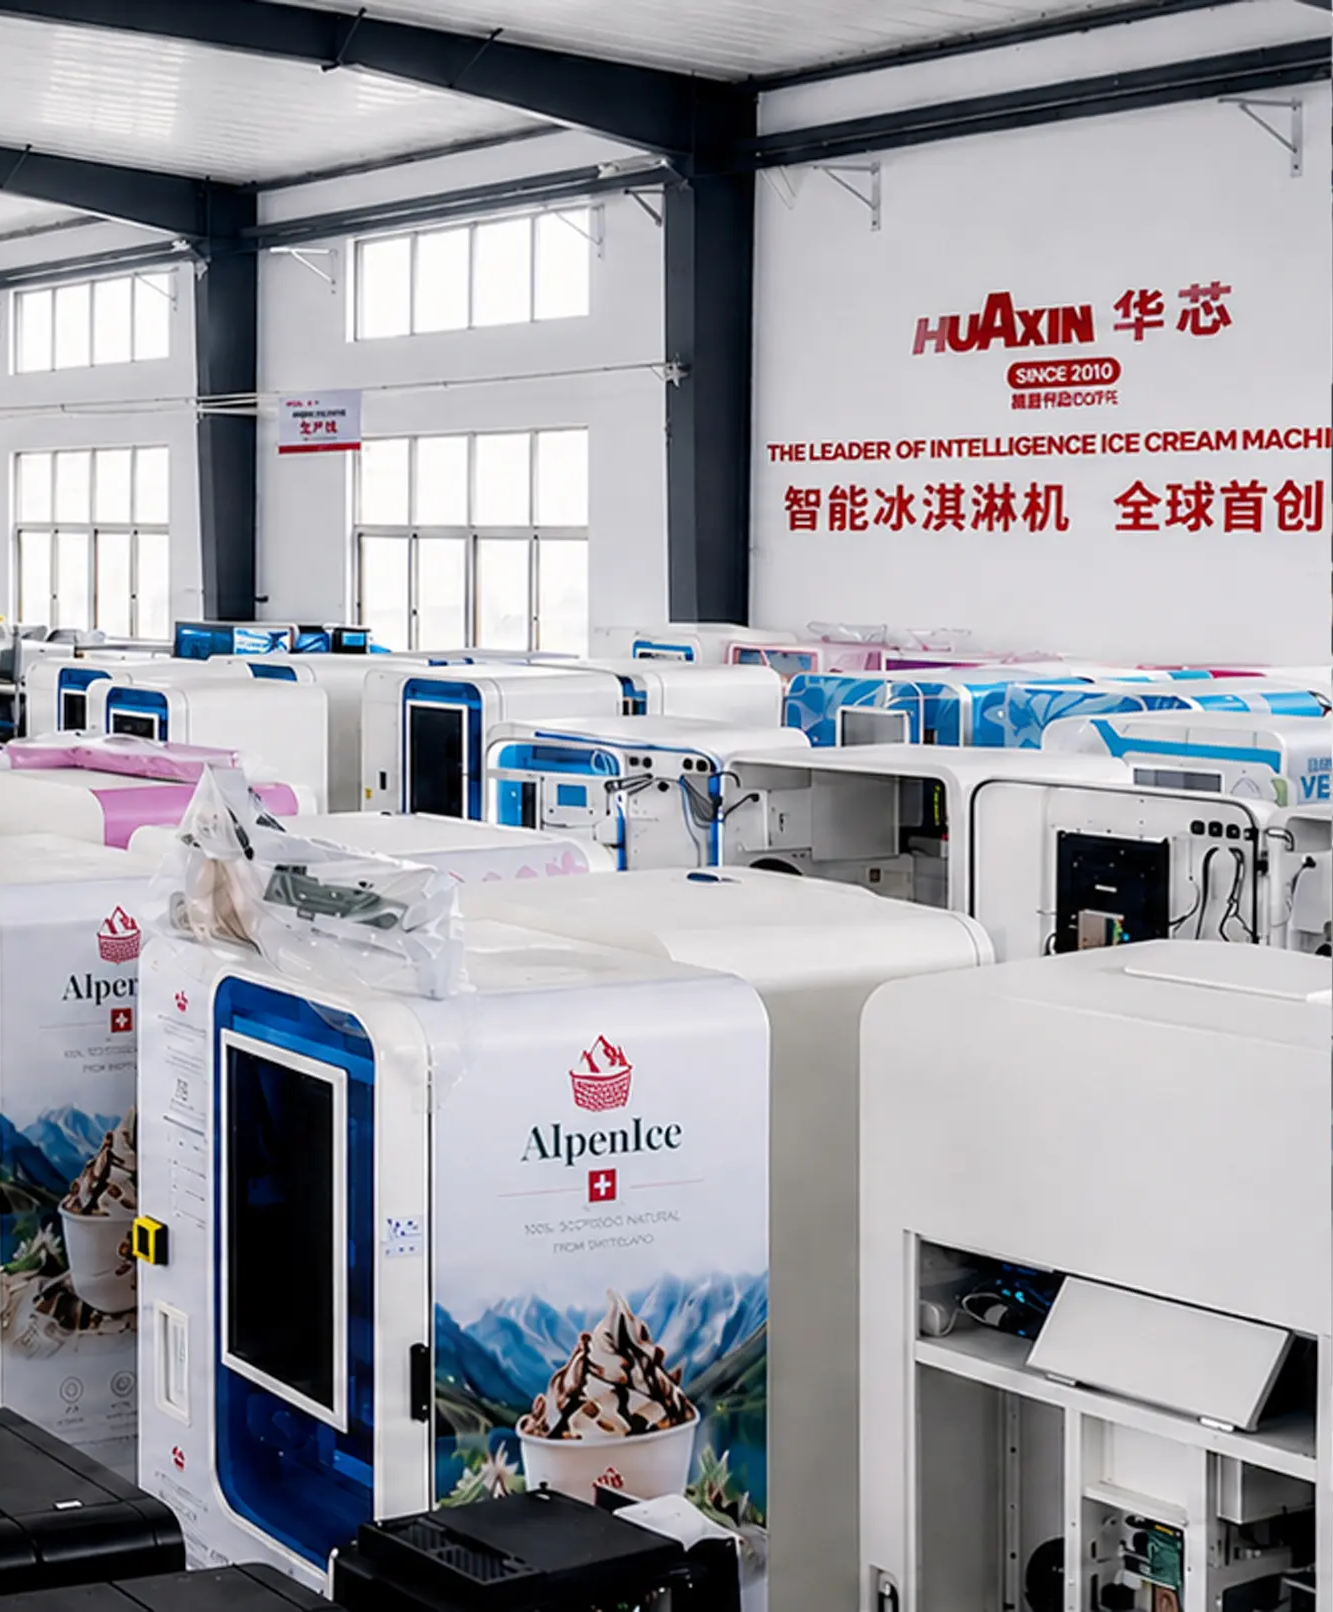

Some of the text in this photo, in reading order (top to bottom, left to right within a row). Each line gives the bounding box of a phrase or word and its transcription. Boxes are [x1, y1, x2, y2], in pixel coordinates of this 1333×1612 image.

[912, 281, 1232, 355] HUAXIN 华芯
[1015, 363, 1113, 385] SINCE 2010
[767, 443, 805, 462] THE
[809, 440, 891, 462] LEADER
[895, 440, 926, 460] OF
[930, 433, 1095, 459] INTELLIGENCE
[1101, 432, 1141, 454] ICE
[1144, 429, 1234, 453] CREAM
[784, 479, 1324, 533] 智能冰淇淋机 全球首创
